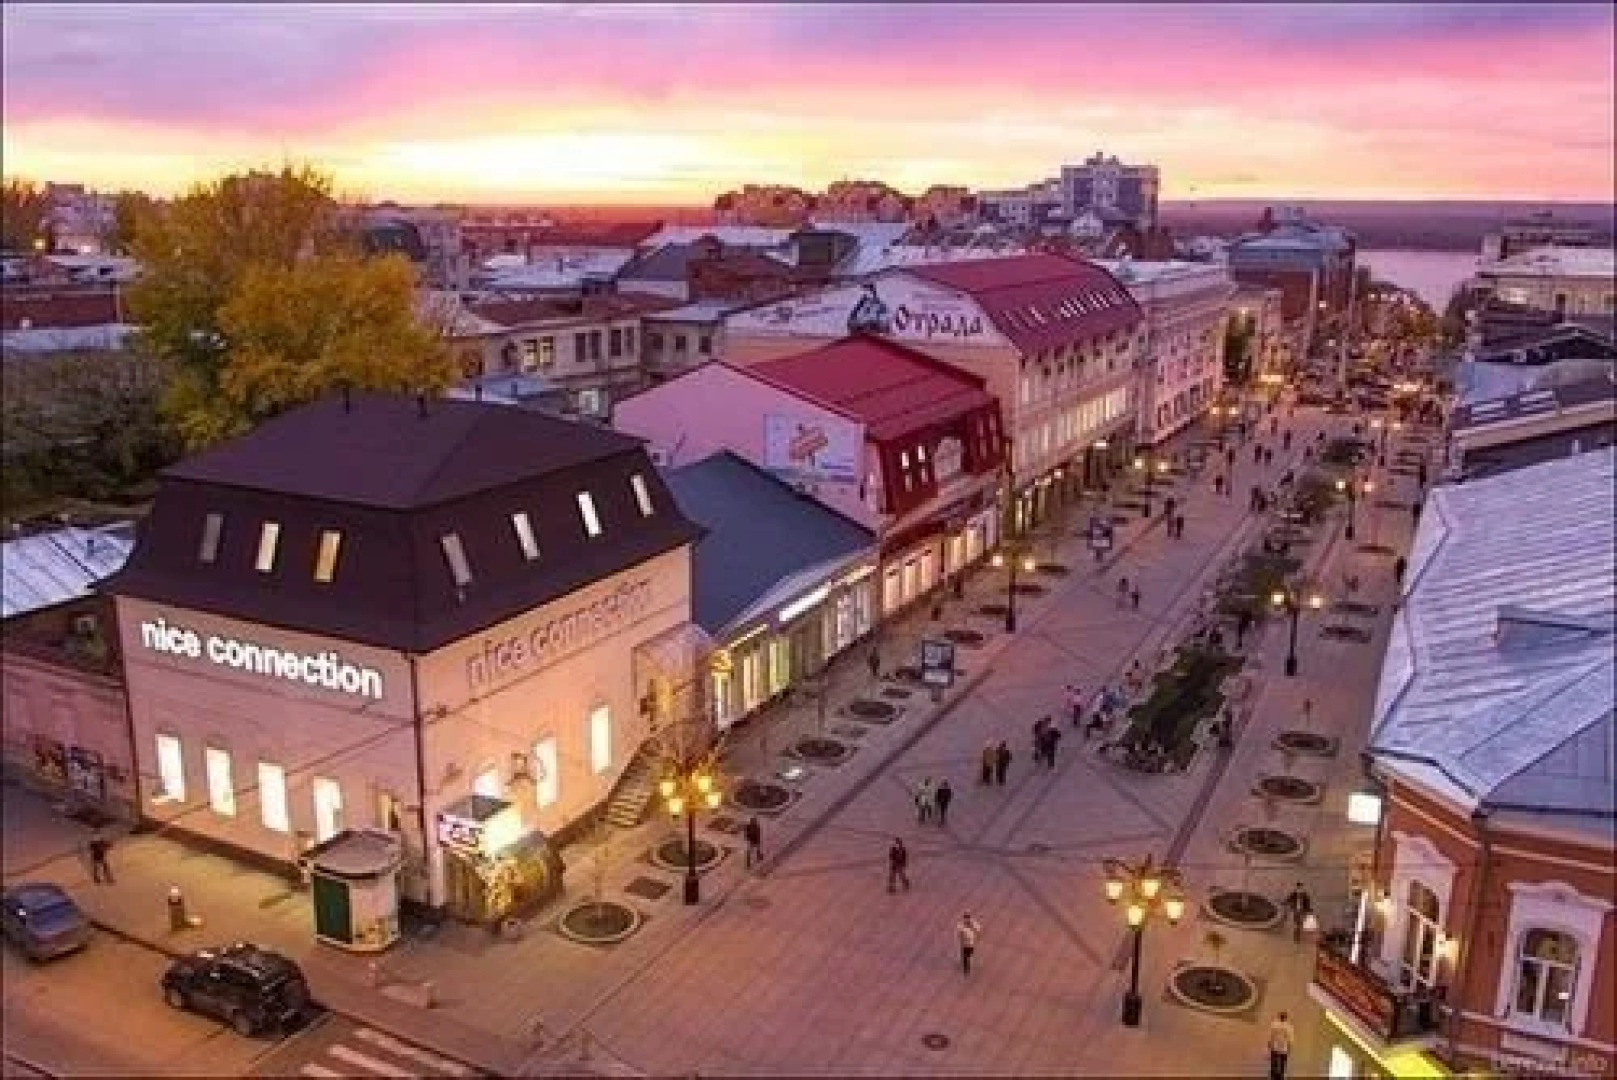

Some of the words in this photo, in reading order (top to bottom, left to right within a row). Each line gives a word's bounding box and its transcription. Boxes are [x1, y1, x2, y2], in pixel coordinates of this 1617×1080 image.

[895, 303, 985, 337] Отрада
[141, 617, 202, 658] nice
[206, 636, 384, 700] connection
